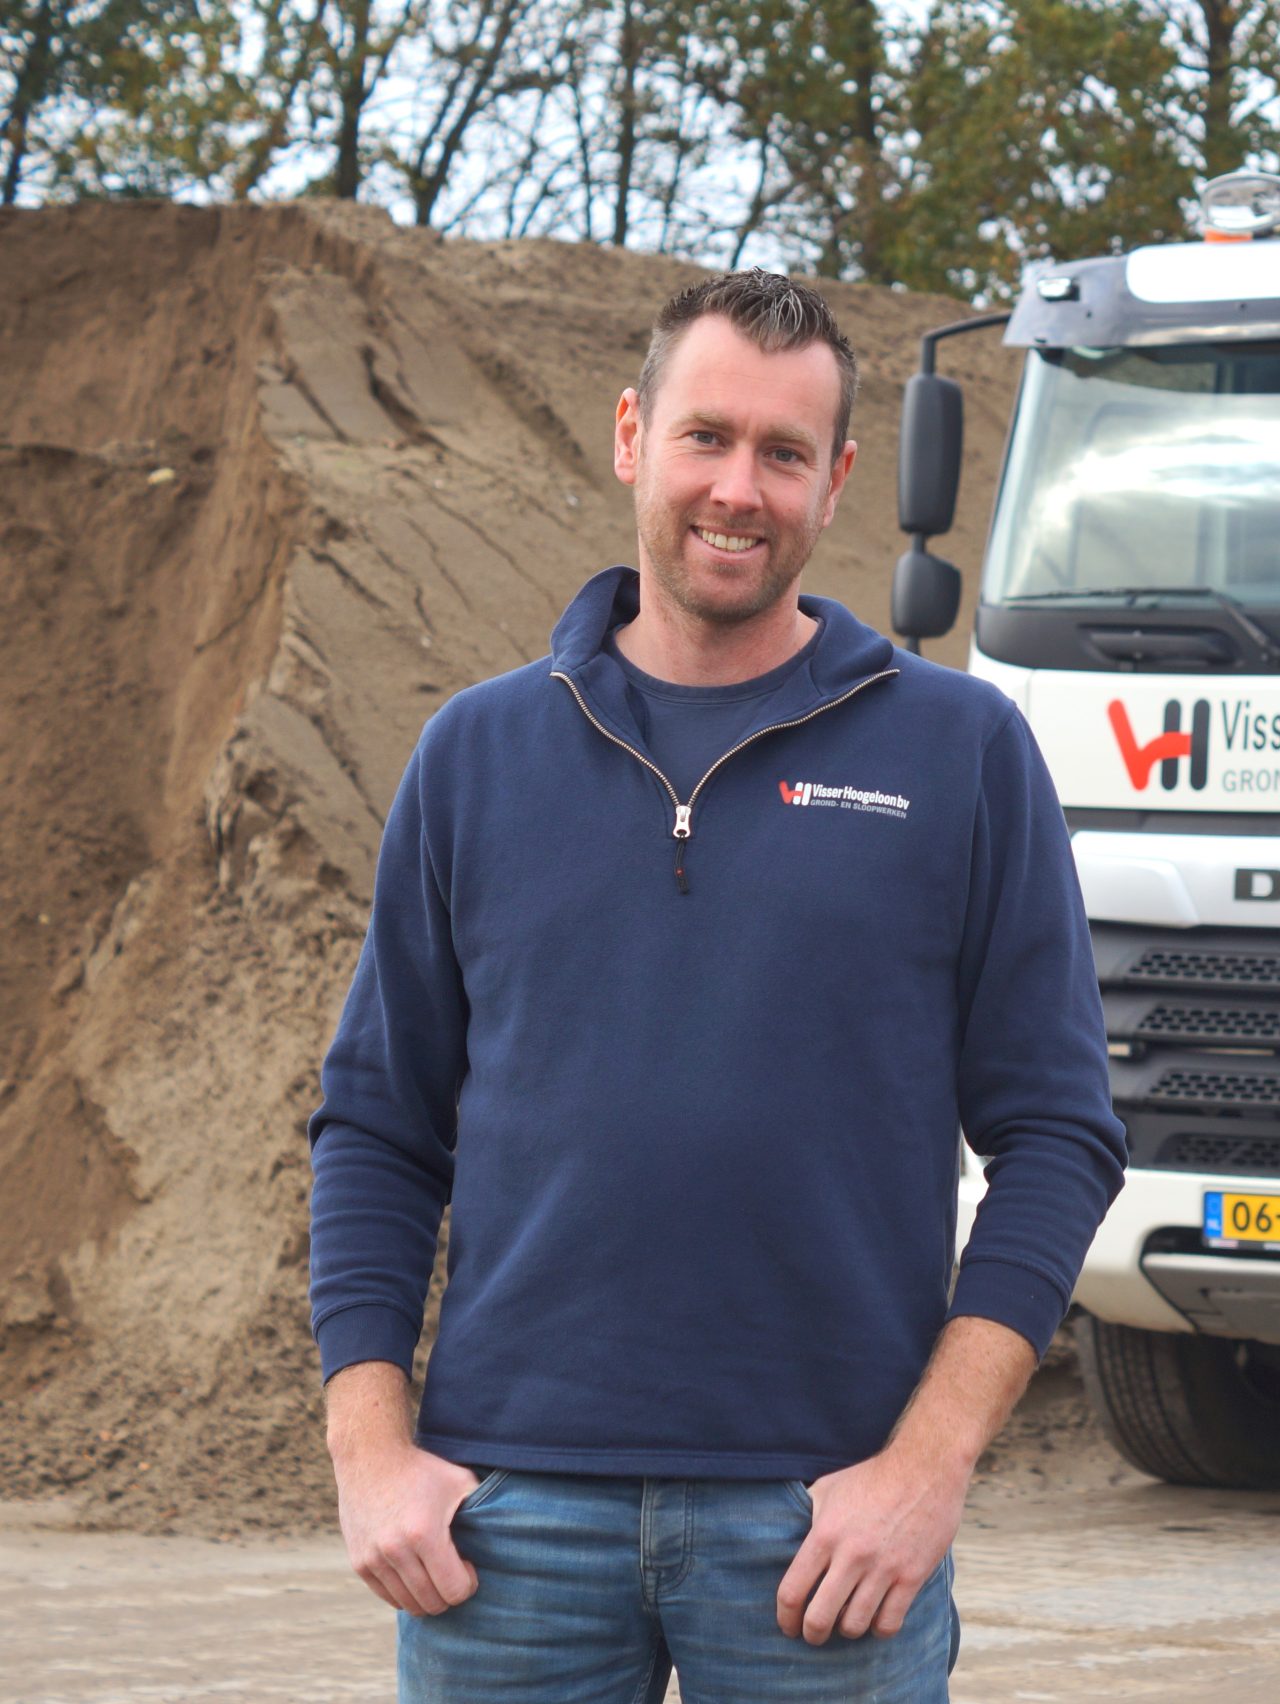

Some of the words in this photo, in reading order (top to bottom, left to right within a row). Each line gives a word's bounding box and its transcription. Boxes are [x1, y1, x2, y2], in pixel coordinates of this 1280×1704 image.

[810, 799, 839, 808] GROND-
[840, 801, 852, 810] EN
[852, 802, 907, 819] SLOOPWERKEN
[813, 783, 843, 800] Visser
[843, 785, 898, 806] Hoogeloon
[897, 794, 910, 811] bv
